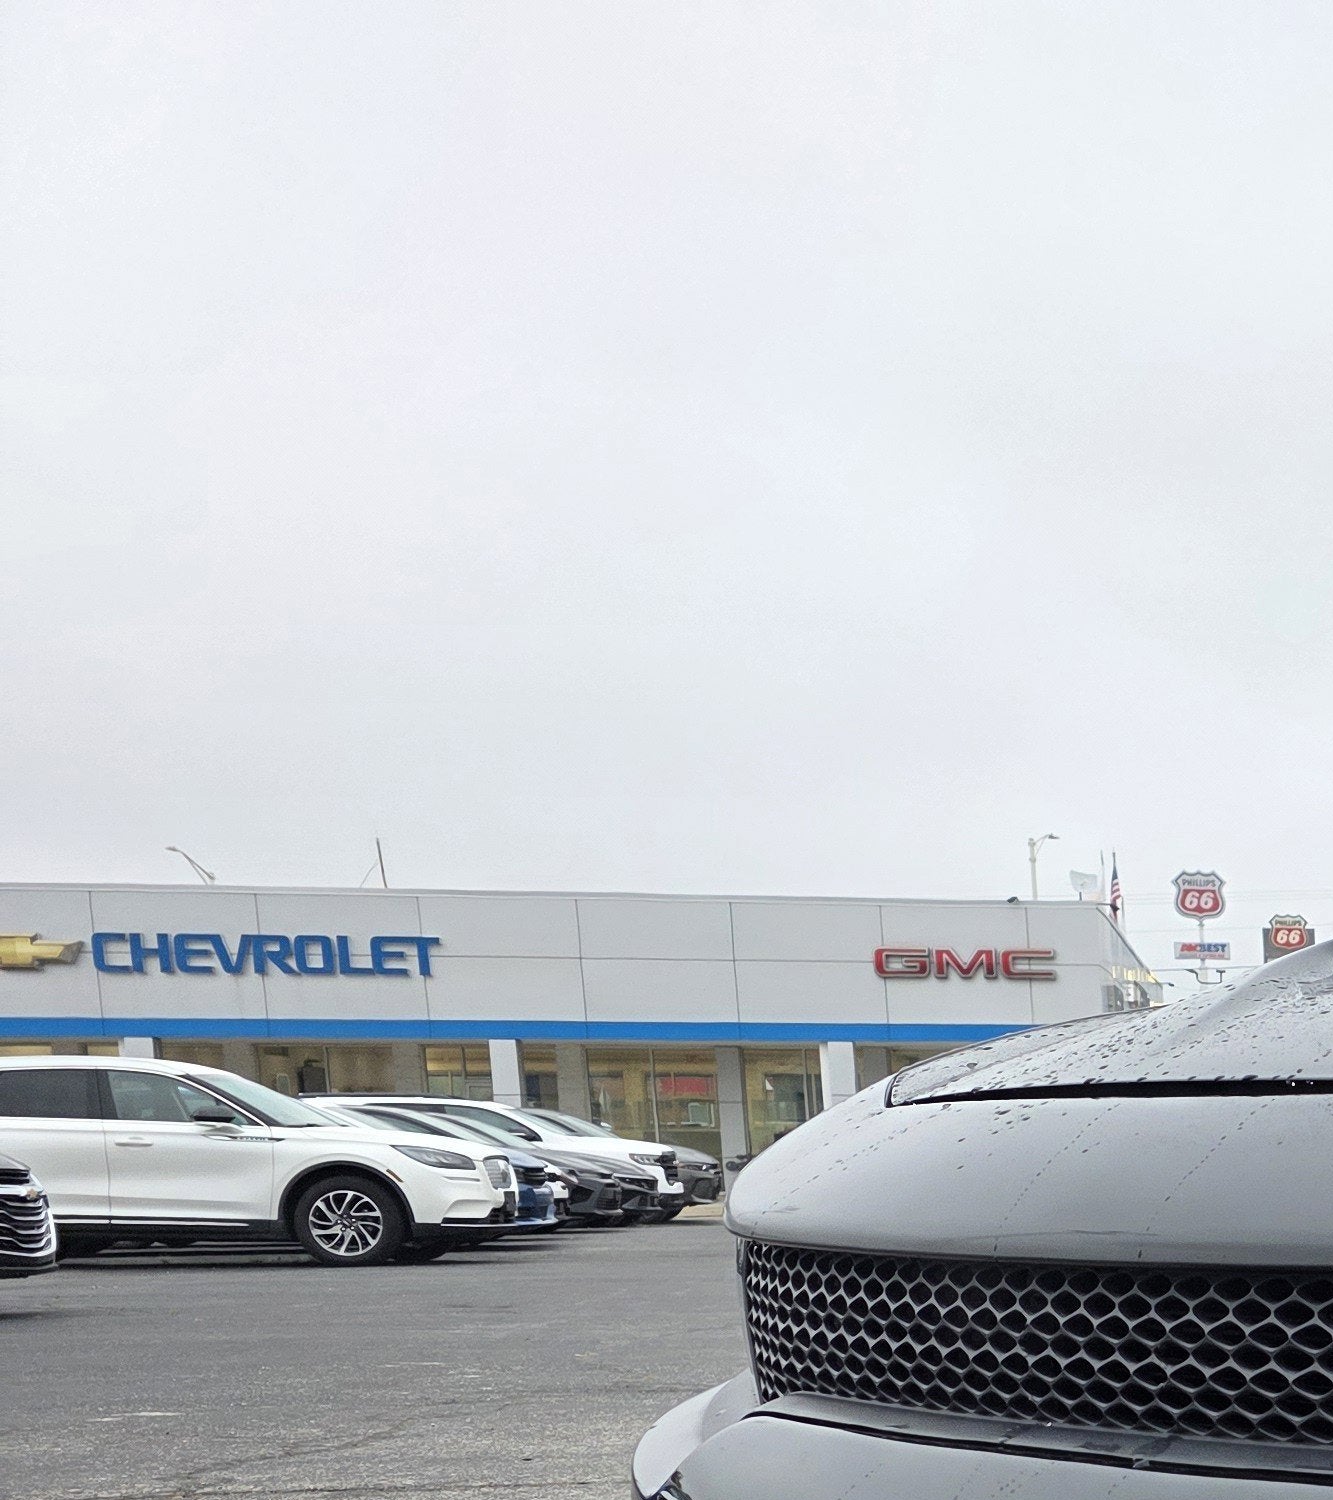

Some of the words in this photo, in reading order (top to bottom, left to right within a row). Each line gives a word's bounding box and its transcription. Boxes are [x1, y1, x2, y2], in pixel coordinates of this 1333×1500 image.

[1181, 878, 1217, 888] PHILLIPS
[1184, 890, 1216, 910] 66
[1274, 919, 1302, 927] PHILLIPS
[1276, 929, 1302, 945] 66
[91, 932, 441, 977] CHEVROLET
[872, 946, 1056, 982] GMC
